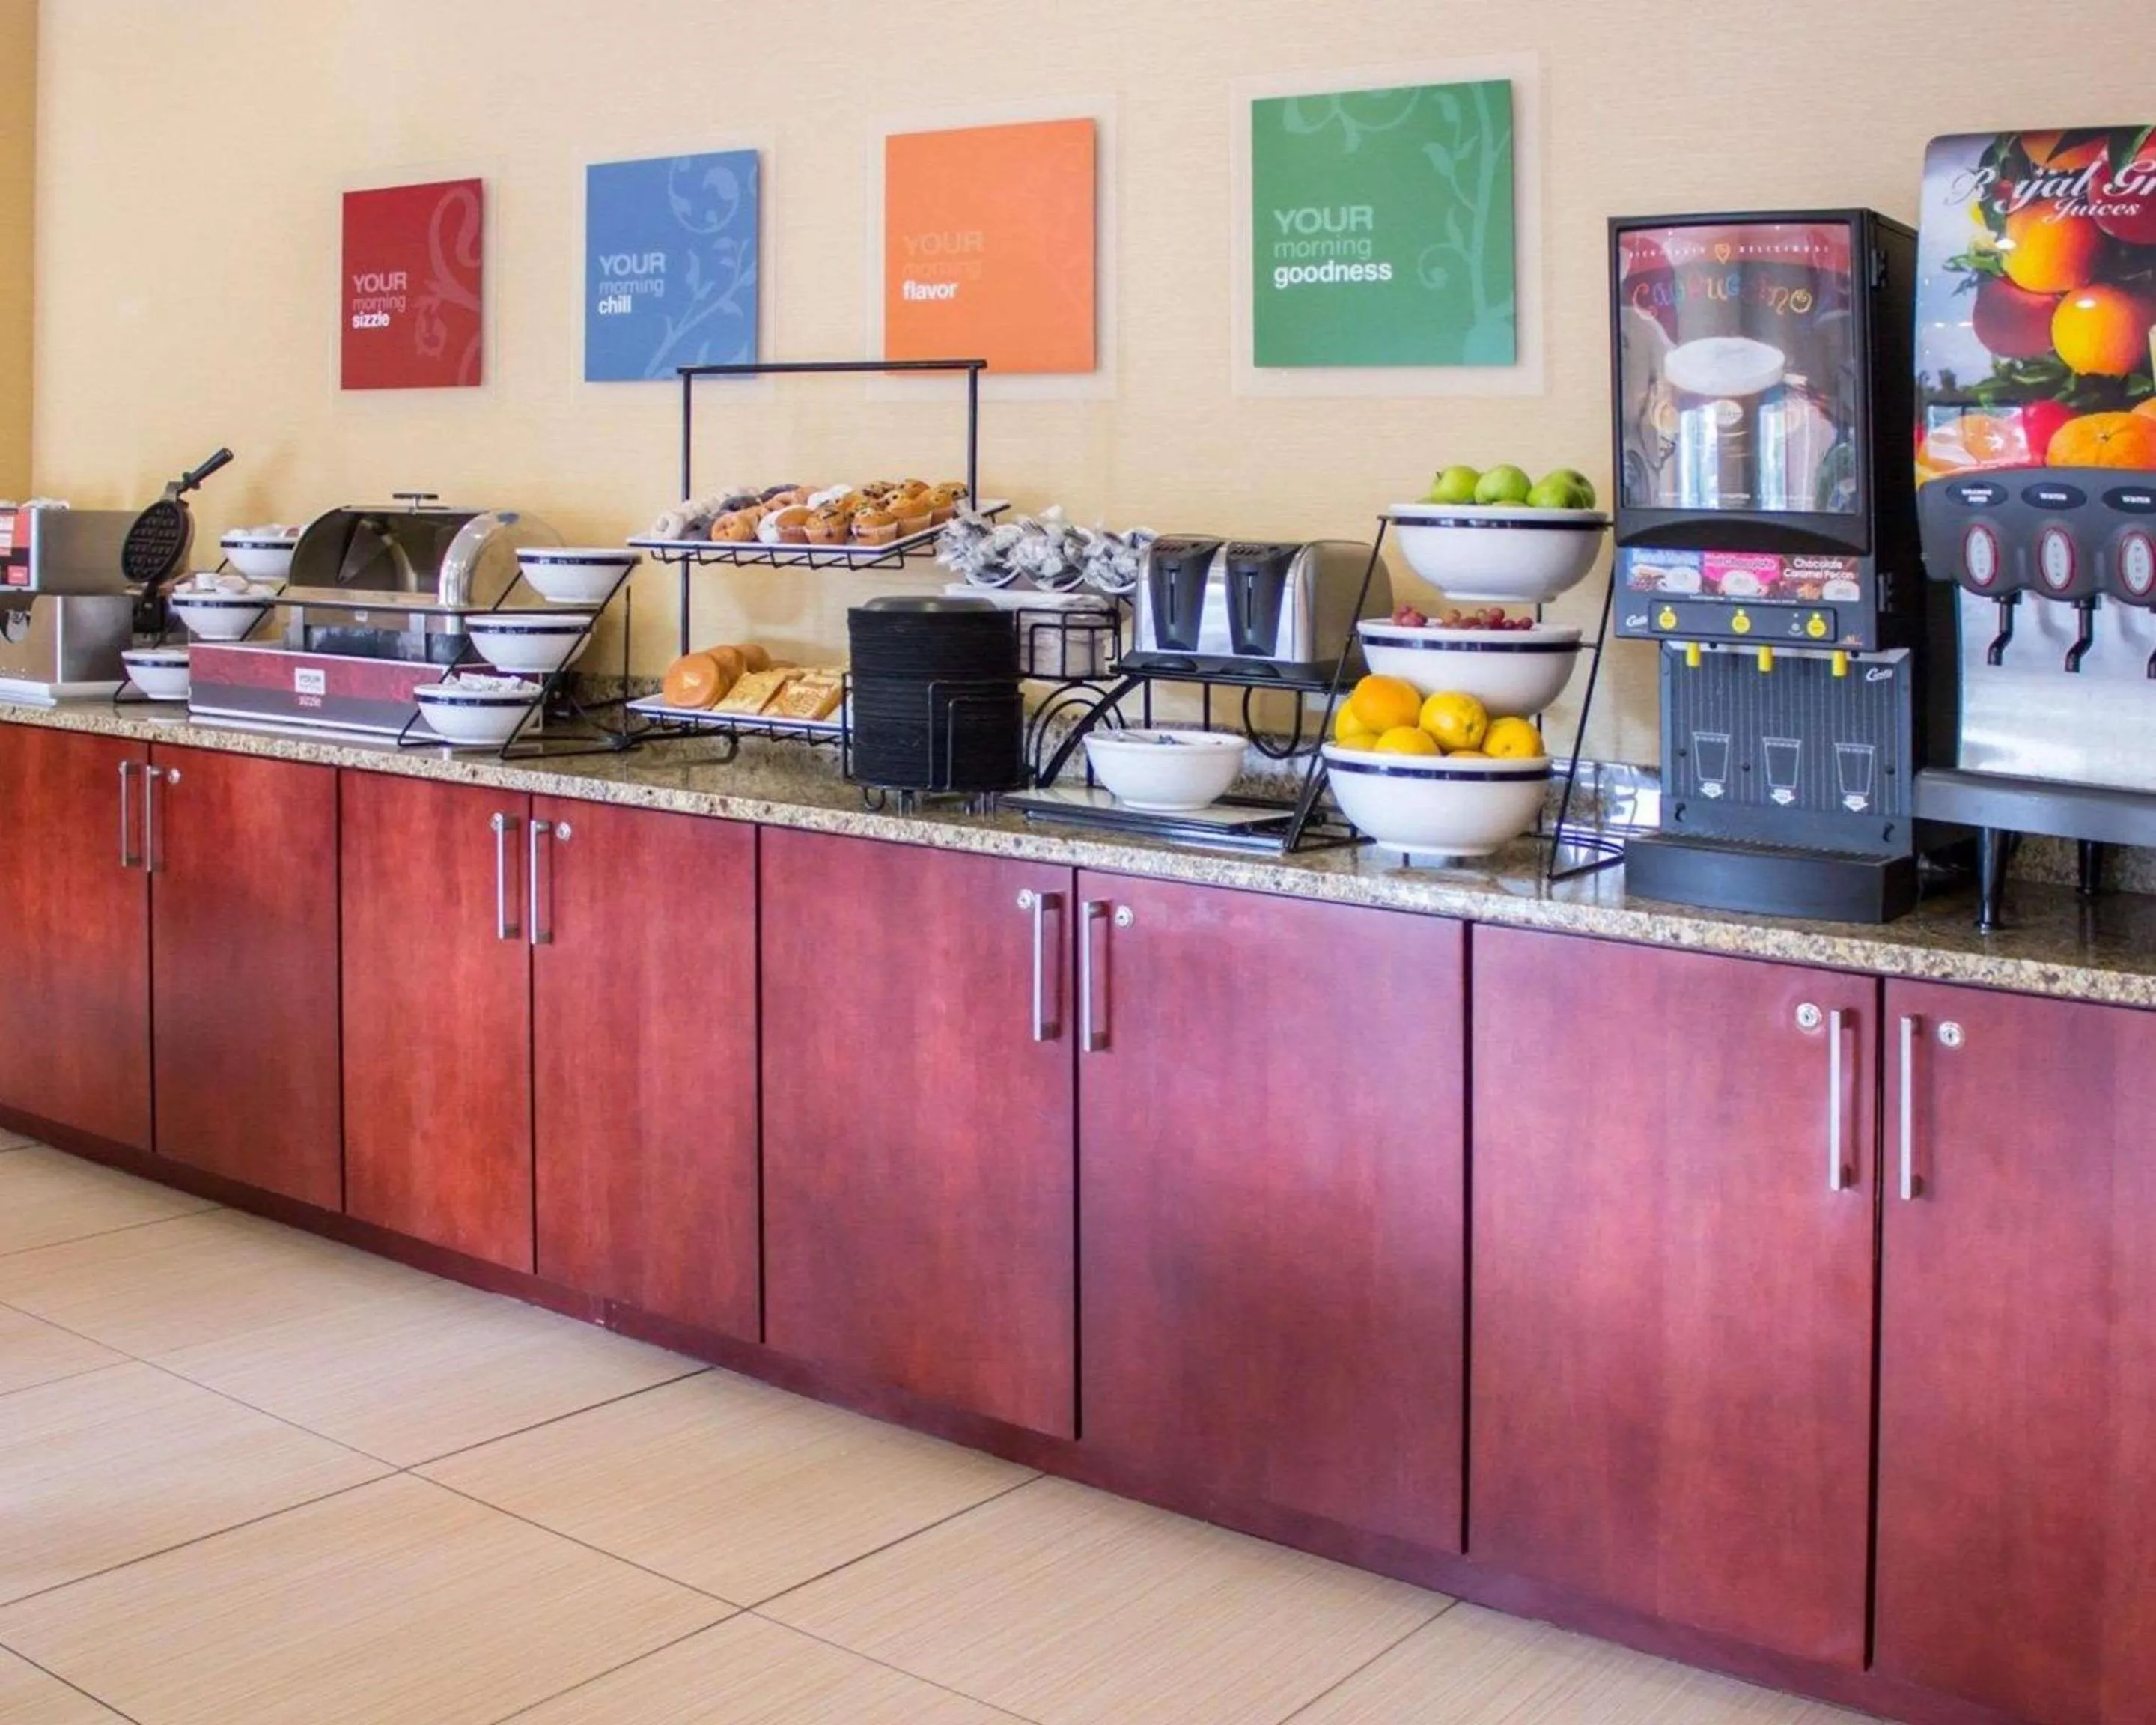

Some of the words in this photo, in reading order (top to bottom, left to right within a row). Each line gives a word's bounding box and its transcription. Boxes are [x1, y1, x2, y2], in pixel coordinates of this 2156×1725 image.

[1944, 155, 2105, 215] Ryal
[1273, 204, 1374, 235] YOUR
[2042, 198, 2140, 223] Juices
[902, 230, 985, 255] YOUR
[1274, 234, 1372, 261] morning
[598, 252, 666, 276] YOUR
[1274, 260, 1393, 290] goodness
[352, 270, 407, 293] YOUR
[598, 278, 665, 298] morning
[903, 279, 958, 300] flavor
[353, 294, 406, 313] morning
[598, 294, 632, 314] chill
[353, 310, 390, 329] sizzle
